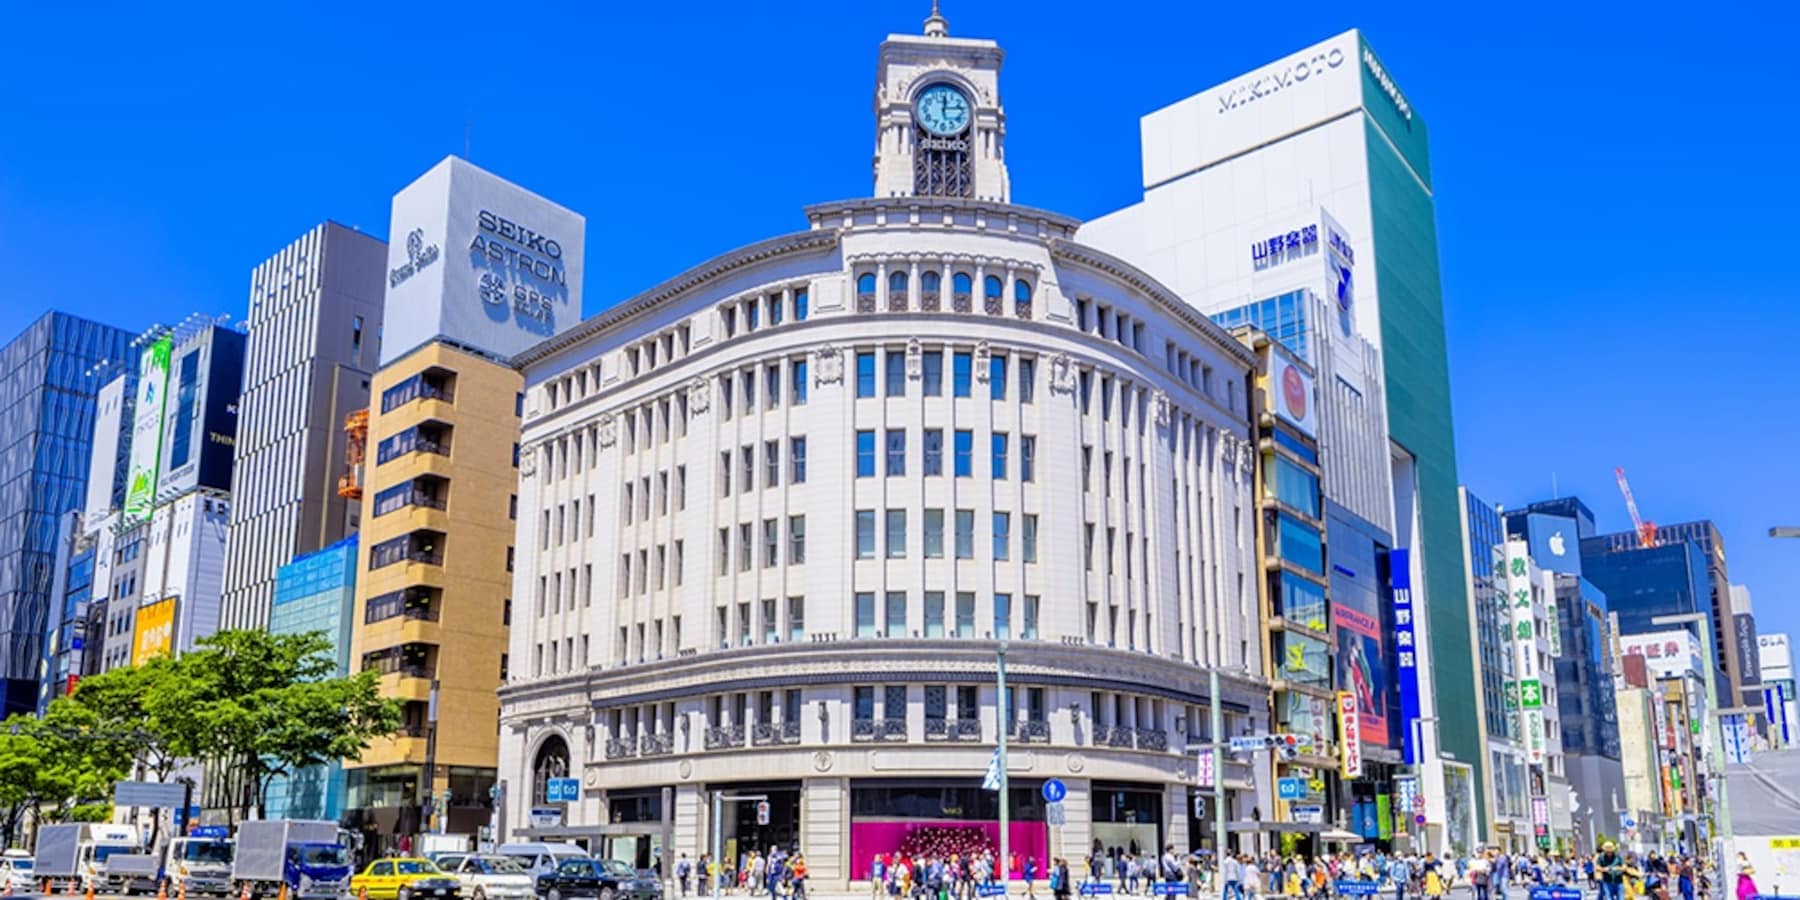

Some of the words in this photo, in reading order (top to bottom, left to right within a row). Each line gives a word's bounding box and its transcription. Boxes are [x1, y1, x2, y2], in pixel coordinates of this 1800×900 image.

[478, 209, 562, 260] SEIKO
[1251, 223, 1317, 260] 山野楽器
[470, 234, 566, 287] ASTRON
[514, 285, 553, 312] GPS
[1511, 557, 1532, 640] 教文館
[1393, 588, 1414, 668] 山野楽器
[1621, 640, 1680, 658] 和証券
[1523, 684, 1539, 704] 本
